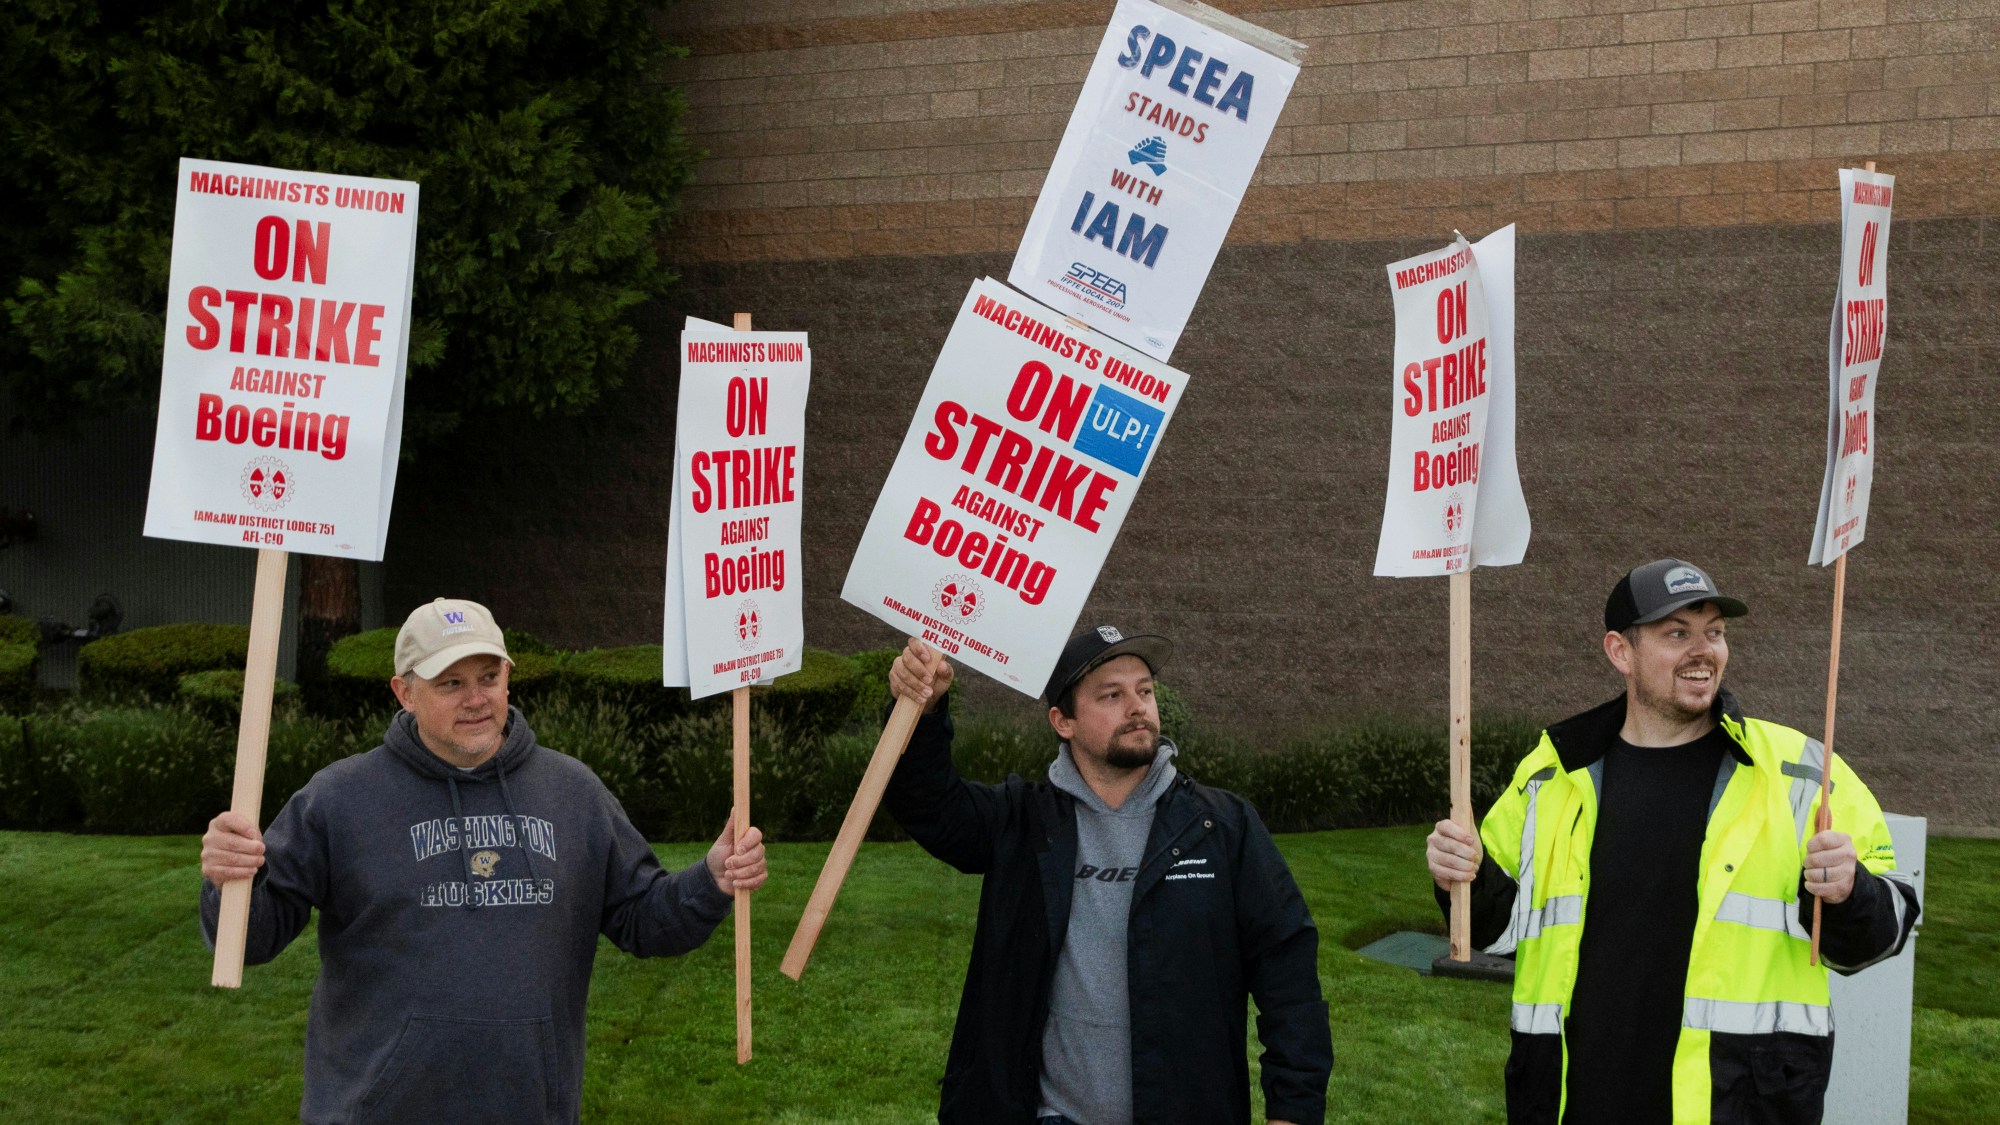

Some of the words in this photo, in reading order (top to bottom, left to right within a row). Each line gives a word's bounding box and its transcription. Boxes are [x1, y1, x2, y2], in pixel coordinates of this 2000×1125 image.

[1118, 25, 1255, 121] SPEEA
[1124, 91, 1209, 143] STANDS
[190, 171, 330, 206] MACHINISTS
[335, 186, 405, 214] UNION
[1110, 169, 1163, 206] WITH
[253, 215, 331, 286] ON
[1071, 191, 1169, 268] IAM
[1396, 250, 1464, 289] MACHINISTS
[1859, 221, 1879, 287] ON
[1047, 279, 1082, 300] PROFESSIONAL
[1083, 297, 1115, 315] AEROSPACE
[1113, 311, 1131, 322] UNION
[1060, 276, 1082, 290] IFPTE
[1081, 286, 1104, 301] LOCAL
[1105, 299, 1125, 310] 2001
[1067, 262, 1127, 304] SPEEA
[186, 286, 384, 367] STRIKE
[1437, 280, 1467, 344] ON
[1845, 299, 1884, 367] STRIKE
[688, 342, 765, 363] MACHINISTS
[768, 342, 803, 362] UNION
[973, 294, 1103, 370] MACHINISTS
[1103, 356, 1171, 403] UNION
[230, 366, 327, 399] AGAINST
[1006, 360, 1092, 442] ON
[1404, 338, 1486, 416] STRIKE
[195, 393, 351, 460] Boeing
[726, 376, 768, 438] ON
[1092, 403, 1150, 449] ULP!
[1432, 412, 1470, 443] AGAINST
[691, 446, 796, 514] STRIKE
[924, 400, 1118, 533] STRIKE
[1413, 441, 1479, 492] Boeing
[194, 510, 236, 525] IAM&AW
[239, 515, 285, 529] DISTRICT
[287, 520, 317, 533] LODGE
[319, 523, 335, 535] 751
[721, 516, 770, 545] AGAINST
[951, 485, 1045, 542] AGAINST
[704, 546, 785, 599] Boeing
[904, 497, 1057, 605] Boeing
[1412, 549, 1443, 560] IAM&AW
[444, 612, 463, 624] W
[883, 596, 922, 621] IAM&AW
[921, 616, 964, 642] DISTRICT
[964, 637, 992, 657] LODGE
[993, 650, 1009, 665] 751
[922, 629, 959, 654] AFL-CIO
[713, 661, 736, 674] IAM&AW
[737, 654, 760, 668] DISTRICT
[761, 650, 776, 662] LODGE
[741, 667, 760, 682] AFL-CIO
[480, 857, 491, 865] W
[1076, 864, 1138, 882] BOE
[420, 878, 554, 907] HUSKIES
